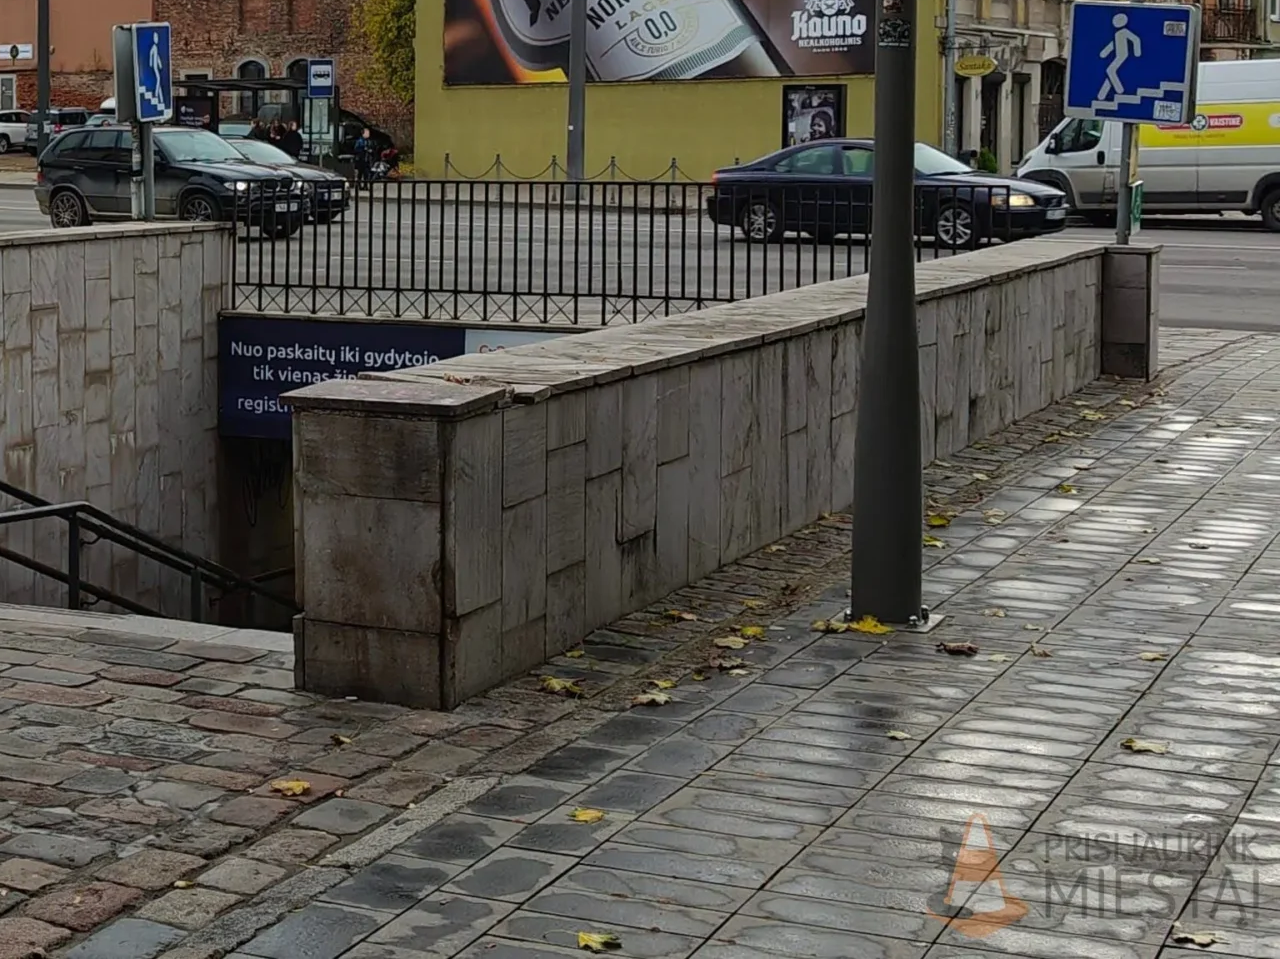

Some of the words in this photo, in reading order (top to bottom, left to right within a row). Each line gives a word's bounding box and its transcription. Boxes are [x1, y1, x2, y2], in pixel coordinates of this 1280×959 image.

[644, 10, 678, 40] 0,0
[790, 10, 867, 41] Kauno
[231, 341, 263, 357] Nuo
[267, 343, 336, 365] paskaitų
[340, 346, 360, 363] iki
[253, 365, 274, 381] tik
[278, 367, 330, 383] vienas
